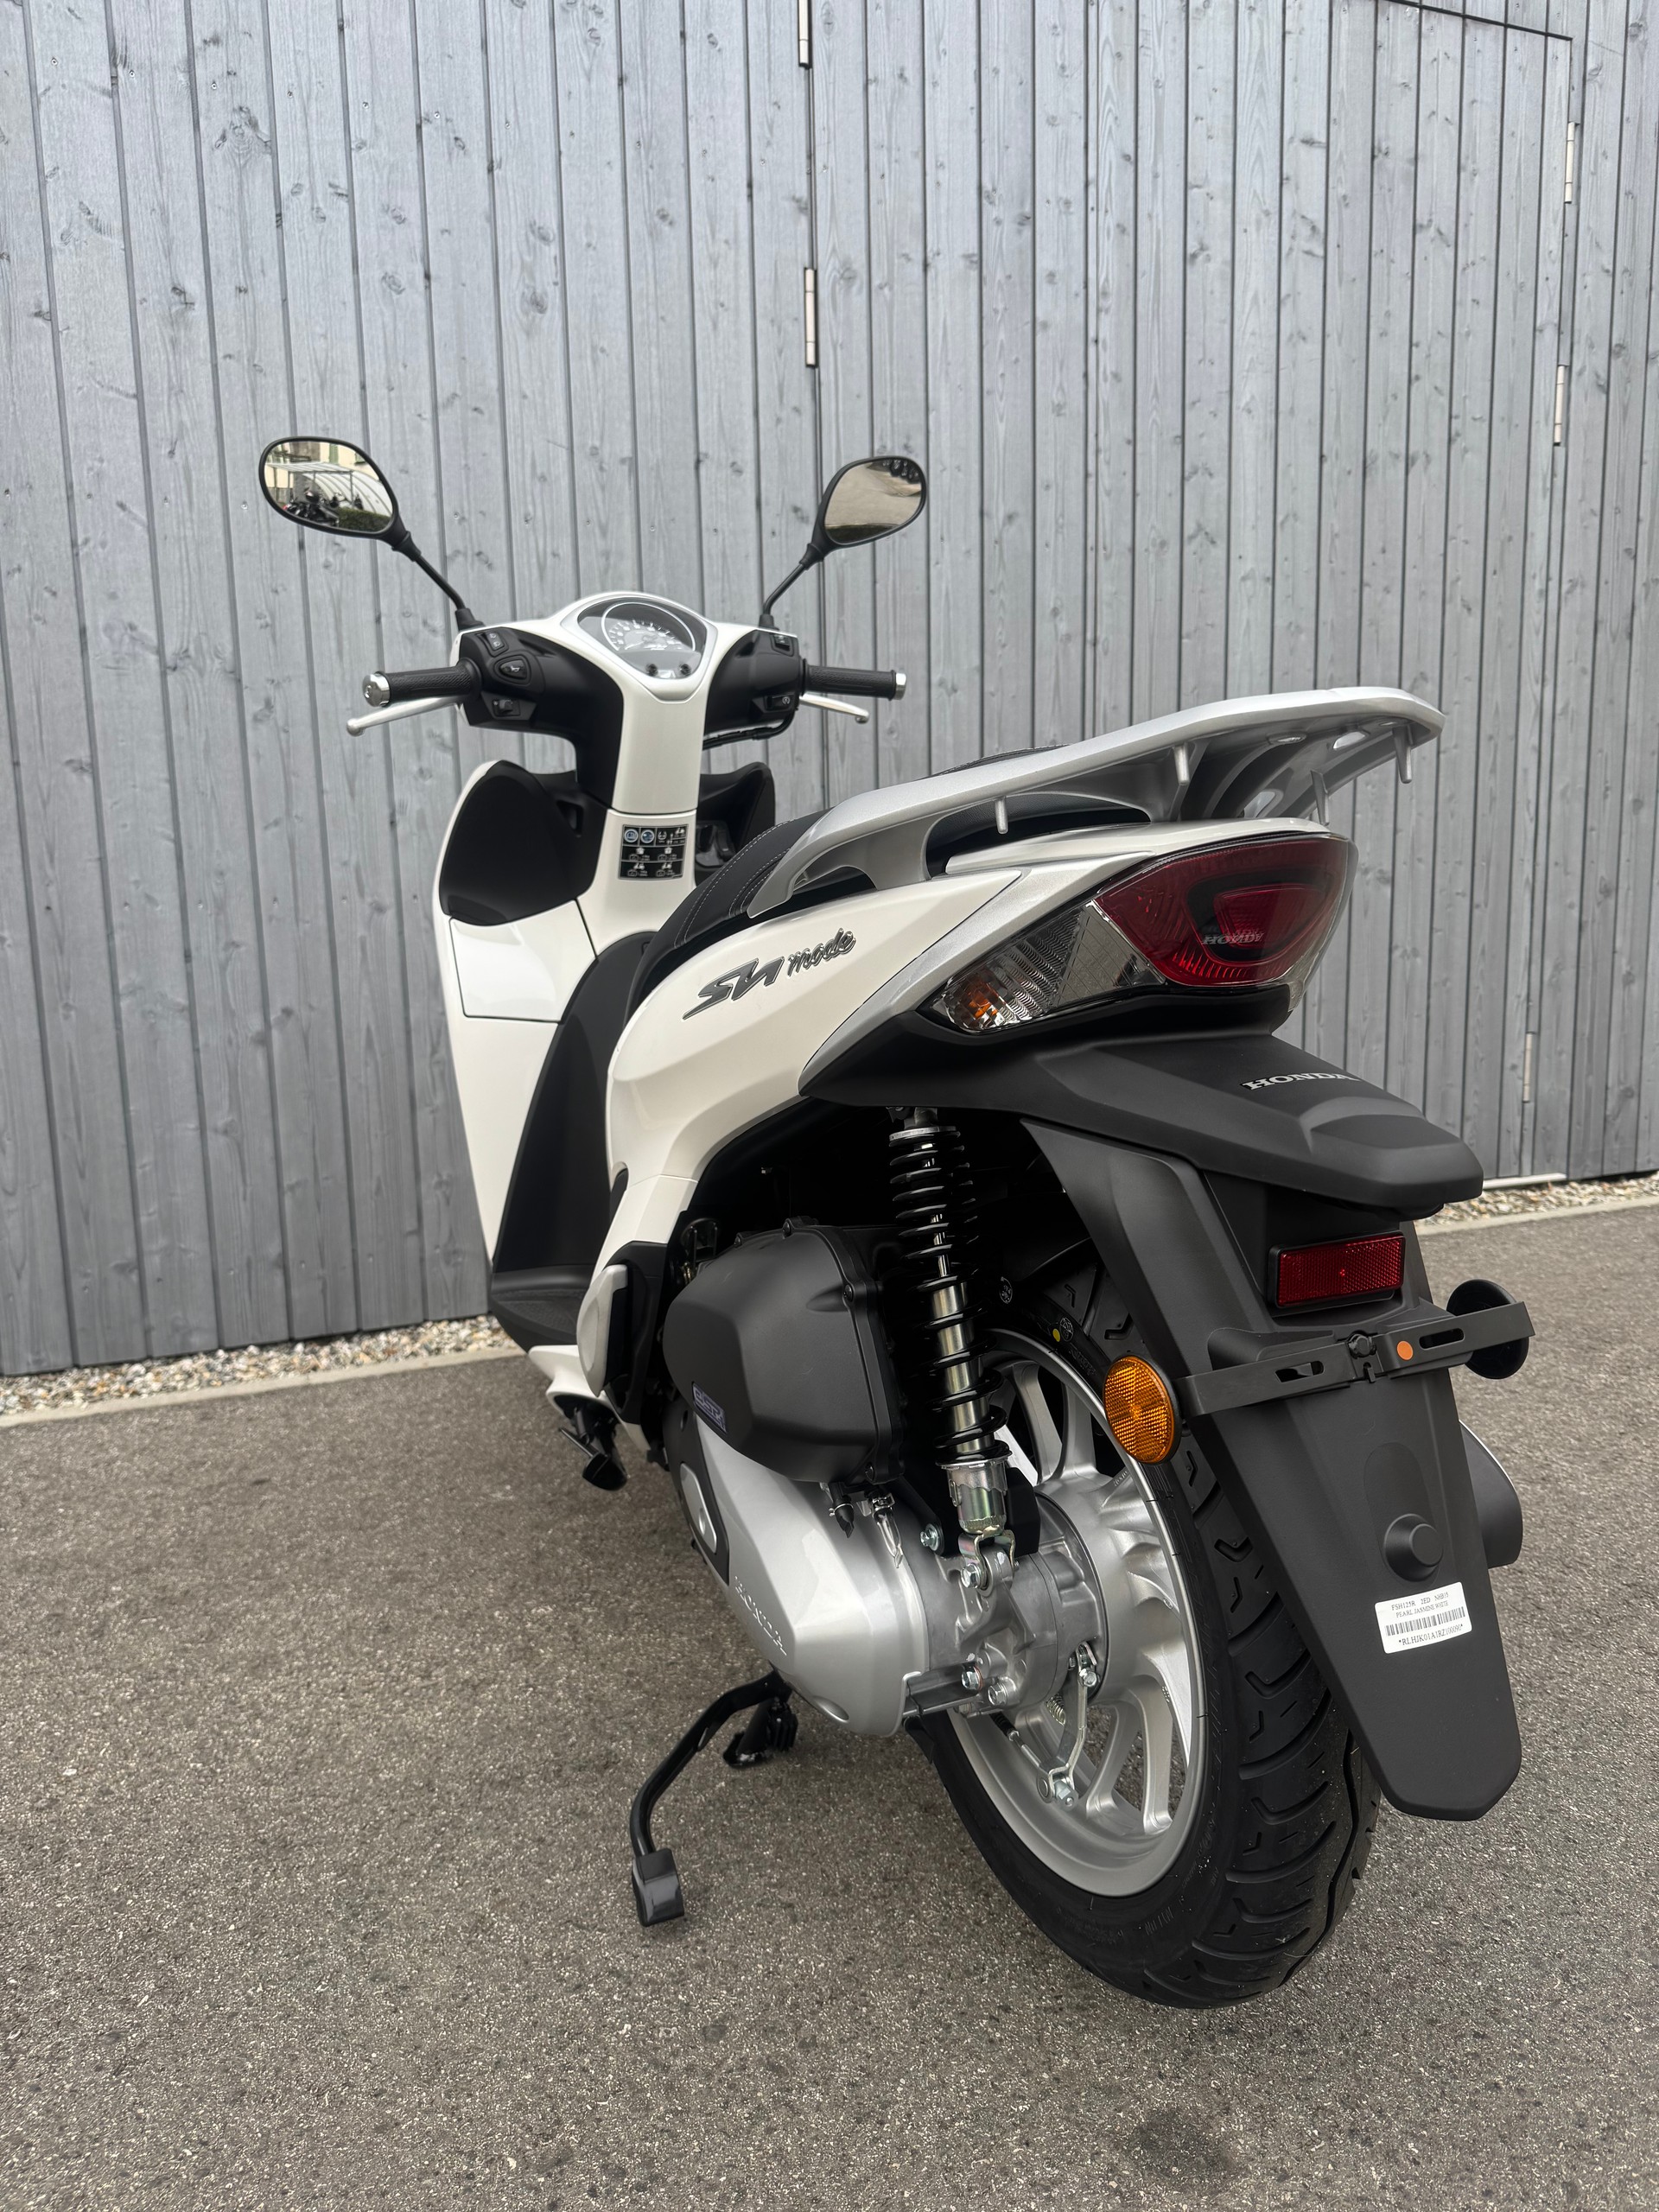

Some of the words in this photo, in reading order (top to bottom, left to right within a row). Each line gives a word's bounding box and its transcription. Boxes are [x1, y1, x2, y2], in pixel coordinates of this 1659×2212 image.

[1202, 932, 1264, 945] HONDA
[786, 927, 857, 977] mode
[1242, 1072, 1362, 1090] HONDA
[1395, 1609, 1414, 1618] PEARL
[1414, 1605, 1434, 1614] JASMINE
[1434, 1599, 1449, 1609] WHITE
